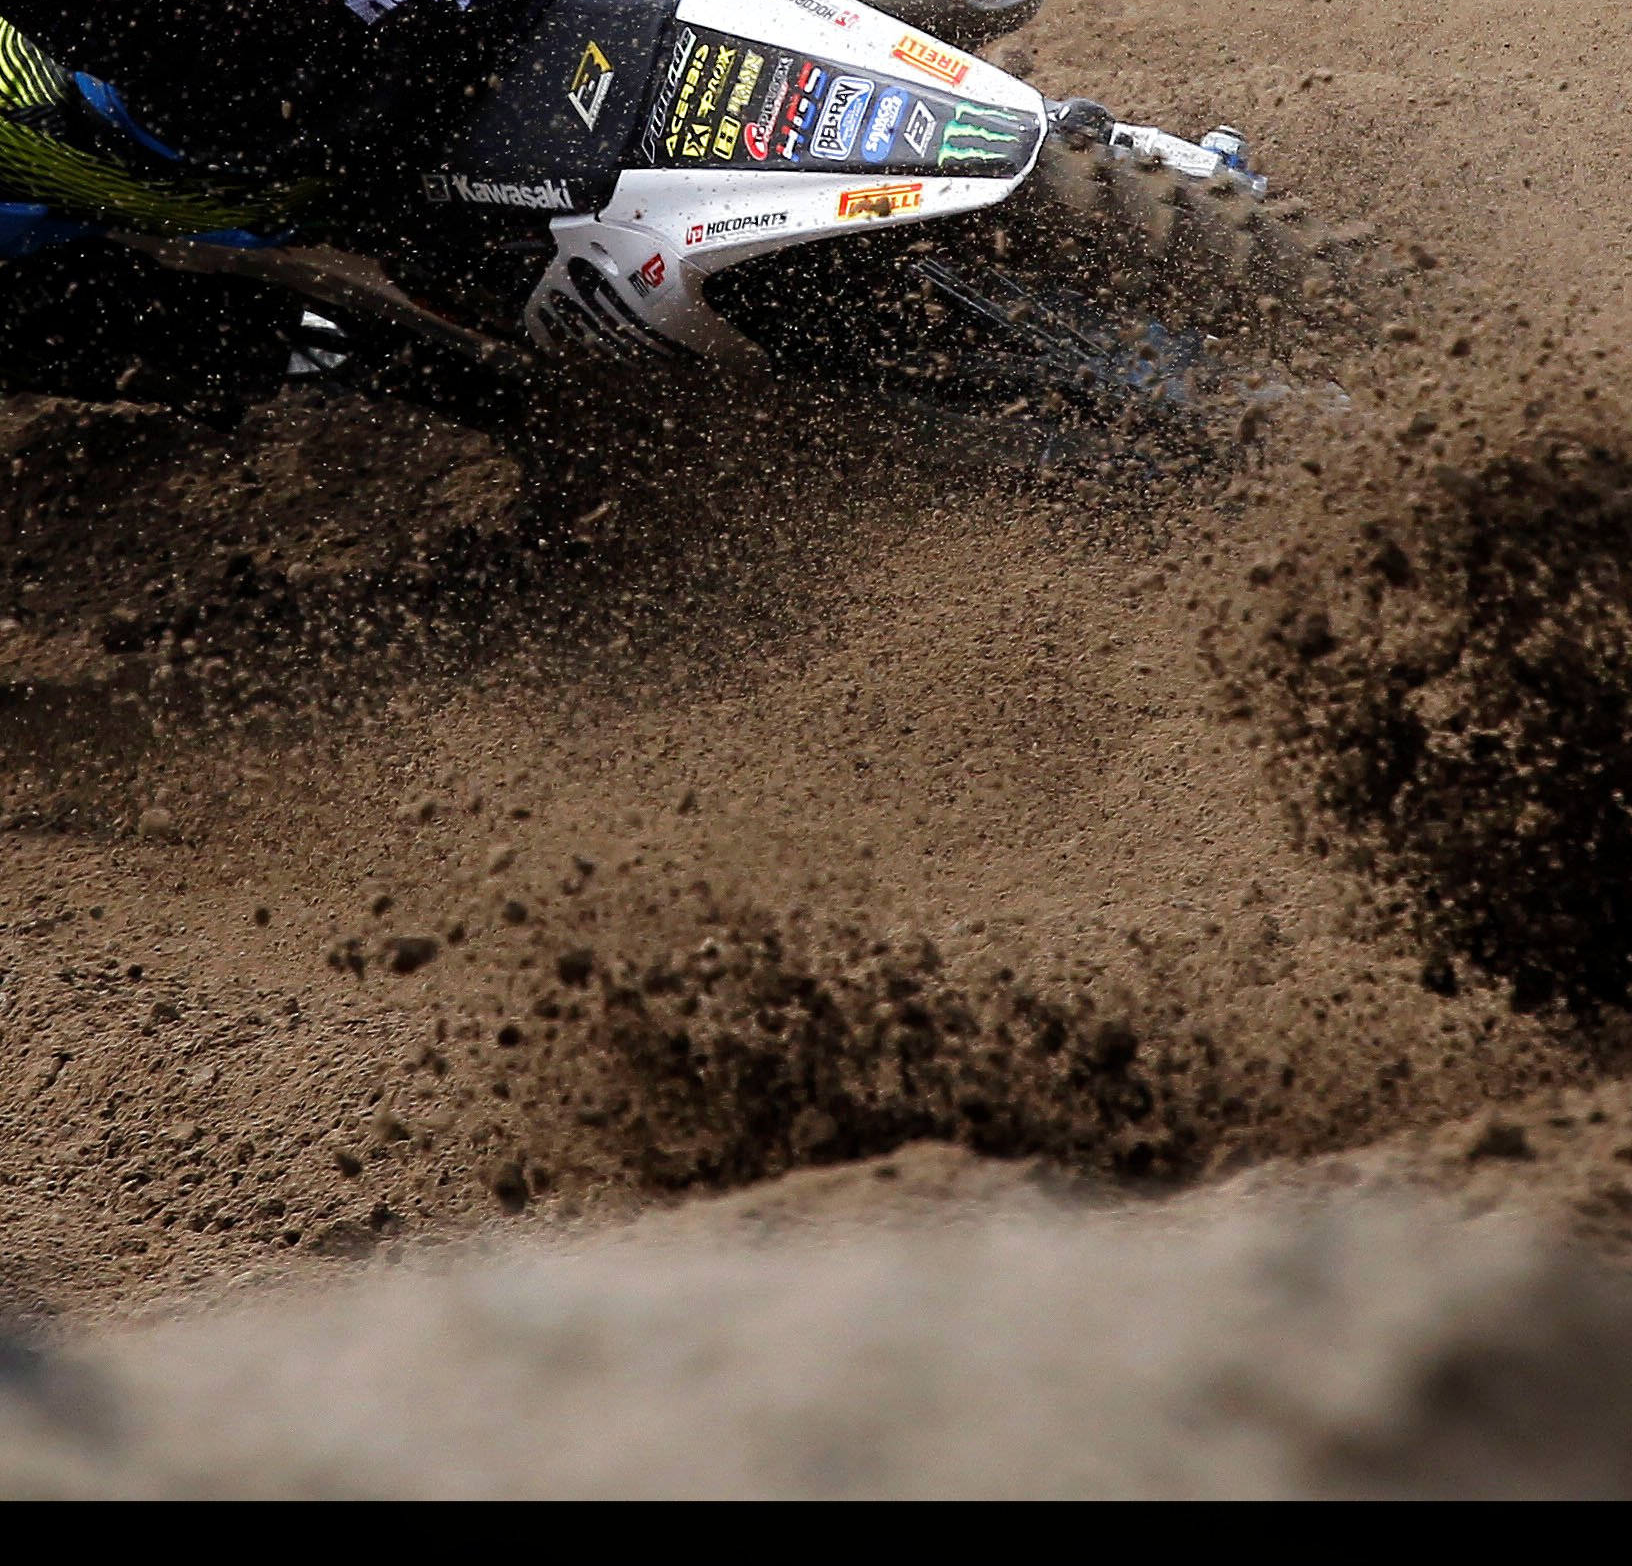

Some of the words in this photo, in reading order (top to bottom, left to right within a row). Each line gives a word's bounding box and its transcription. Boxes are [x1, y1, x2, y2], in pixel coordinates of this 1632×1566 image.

[892, 34, 970, 85] PIRELLI
[665, 43, 710, 158] ACERBIS
[451, 173, 576, 210] Kawasaki
[705, 211, 789, 236] HOCOPARTS
